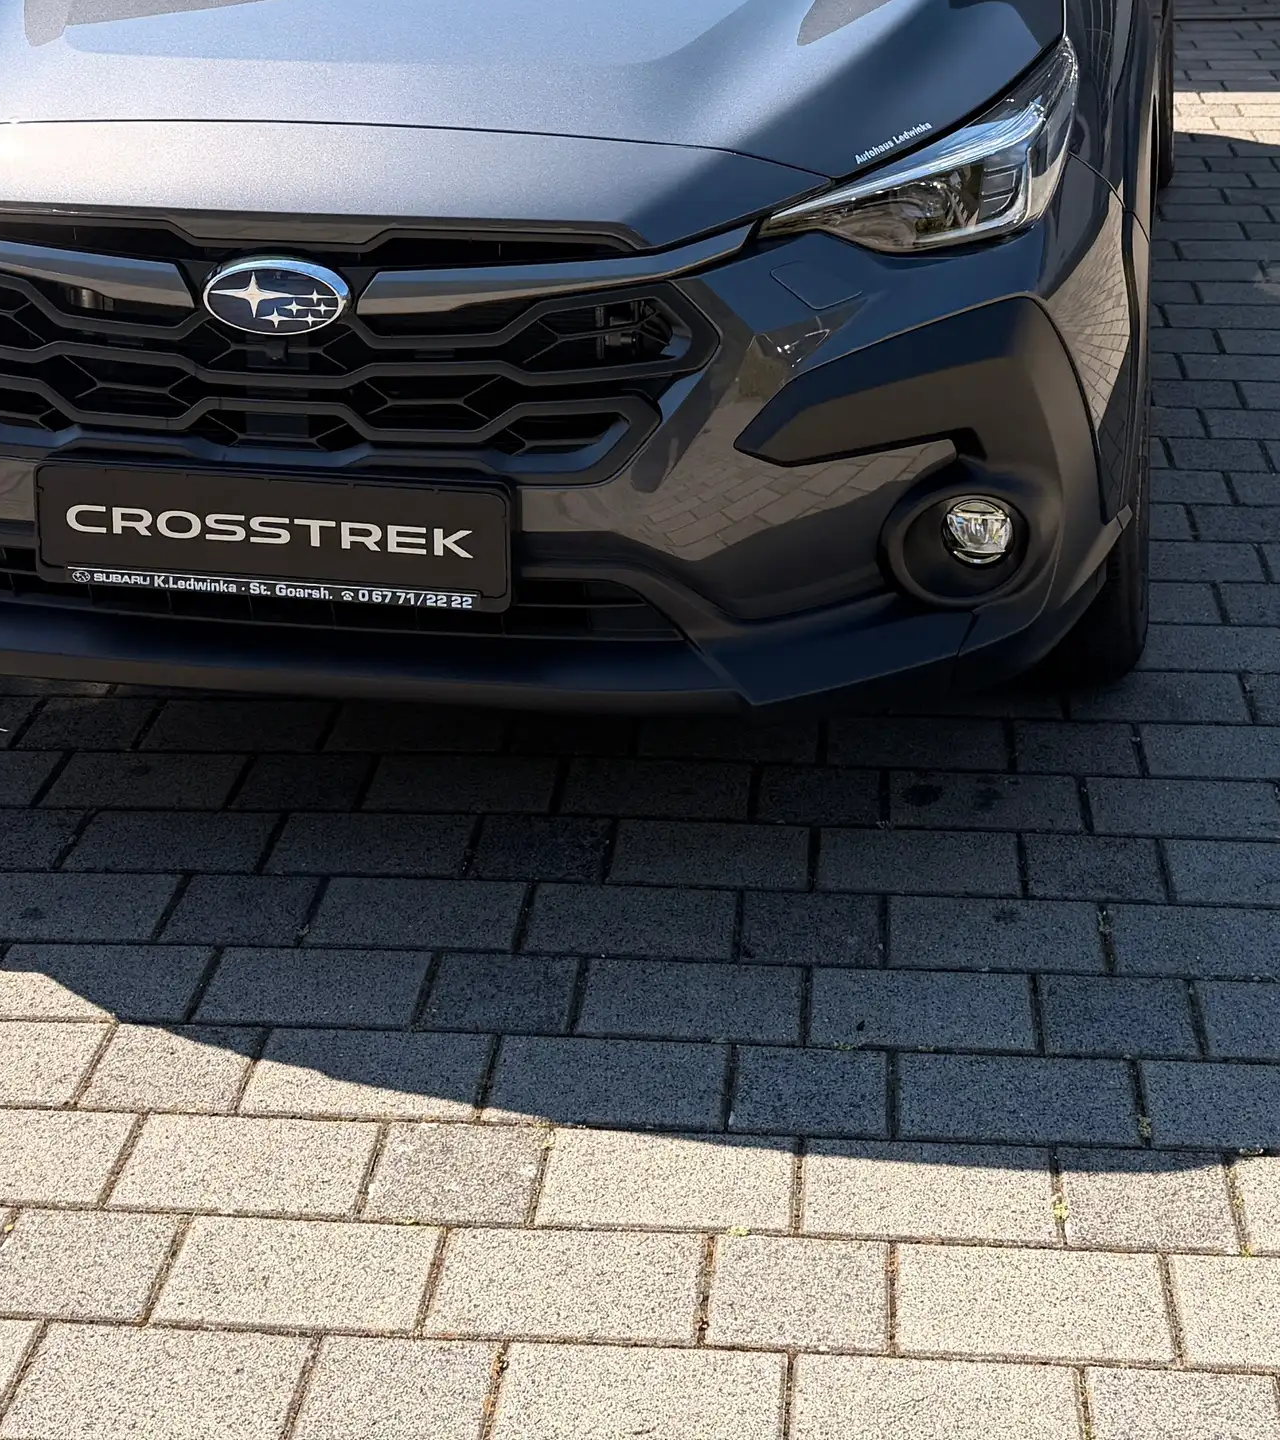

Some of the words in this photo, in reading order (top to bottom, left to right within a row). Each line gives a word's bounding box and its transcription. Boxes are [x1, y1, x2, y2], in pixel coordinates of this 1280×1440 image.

[854, 140, 893, 164] Autohaus
[66, 503, 474, 559] CROSSTREK
[93, 573, 150, 585] SUBARU
[249, 582, 271, 595] St.
[275, 584, 333, 600] Goarsh.
[358, 590, 369, 602] 0
[372, 591, 392, 604] 67
[396, 593, 448, 608] 71/22
[451, 595, 473, 609] 22
